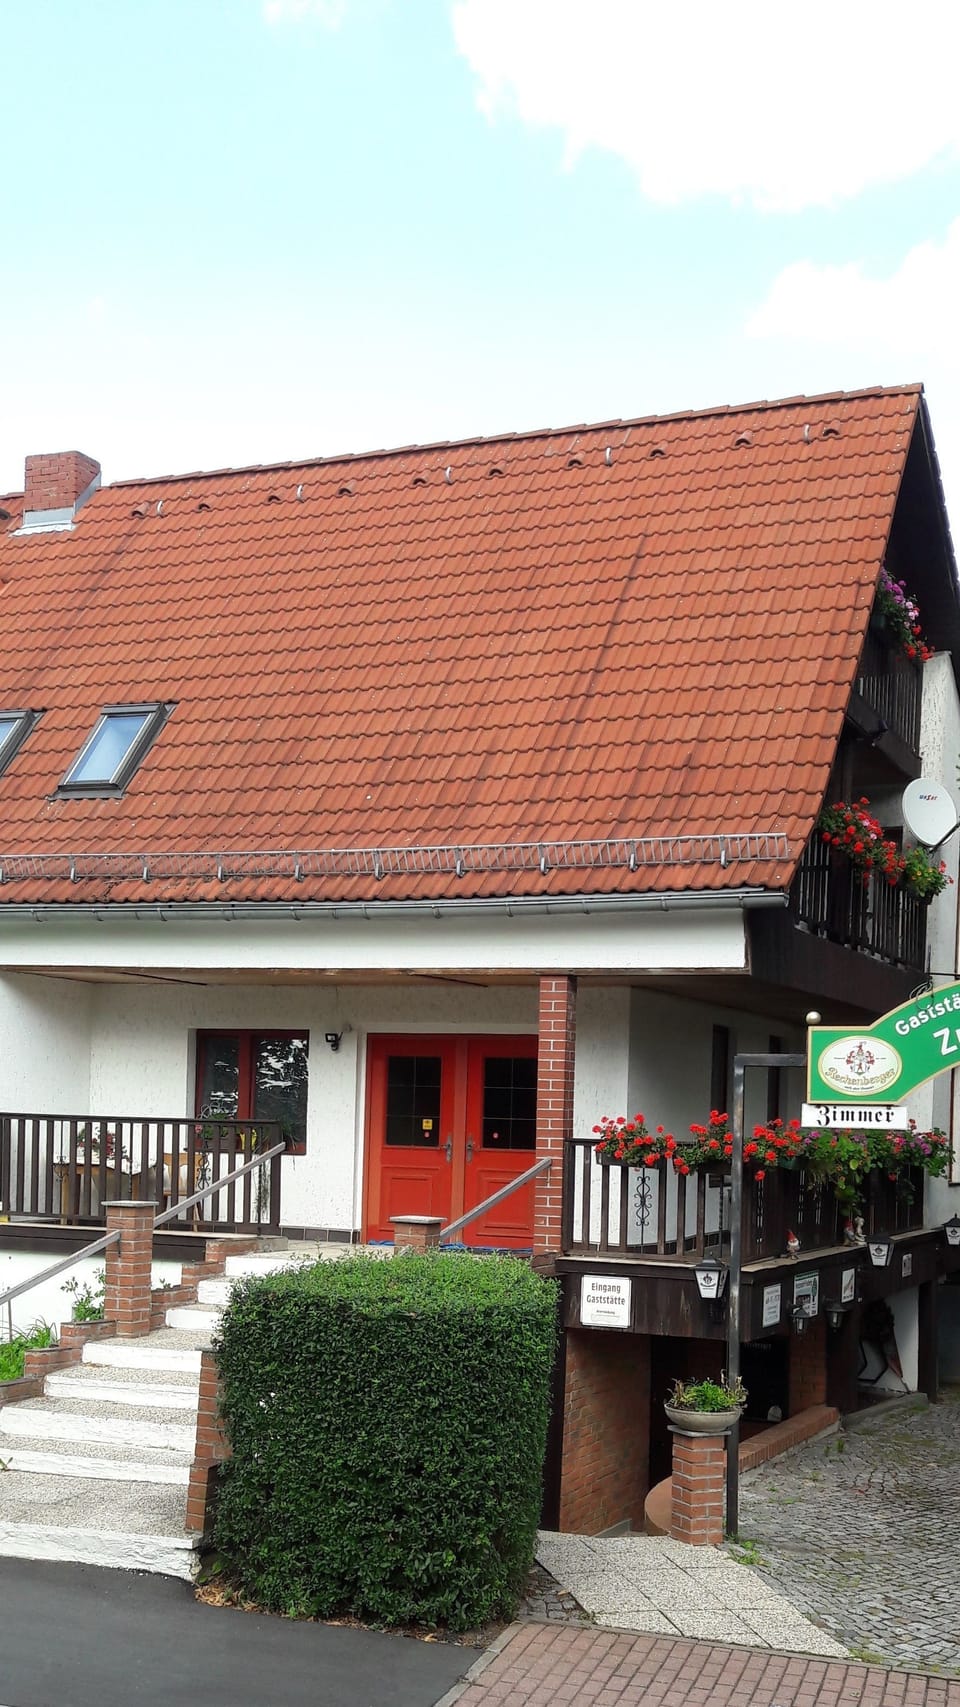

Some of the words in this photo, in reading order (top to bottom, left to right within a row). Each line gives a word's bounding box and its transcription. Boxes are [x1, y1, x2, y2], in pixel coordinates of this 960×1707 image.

[932, 1027, 960, 1056] Z
[816, 1105, 895, 1127] Zimmer
[591, 1282, 621, 1294] Eingang
[586, 1294, 626, 1306] Gaststätte
